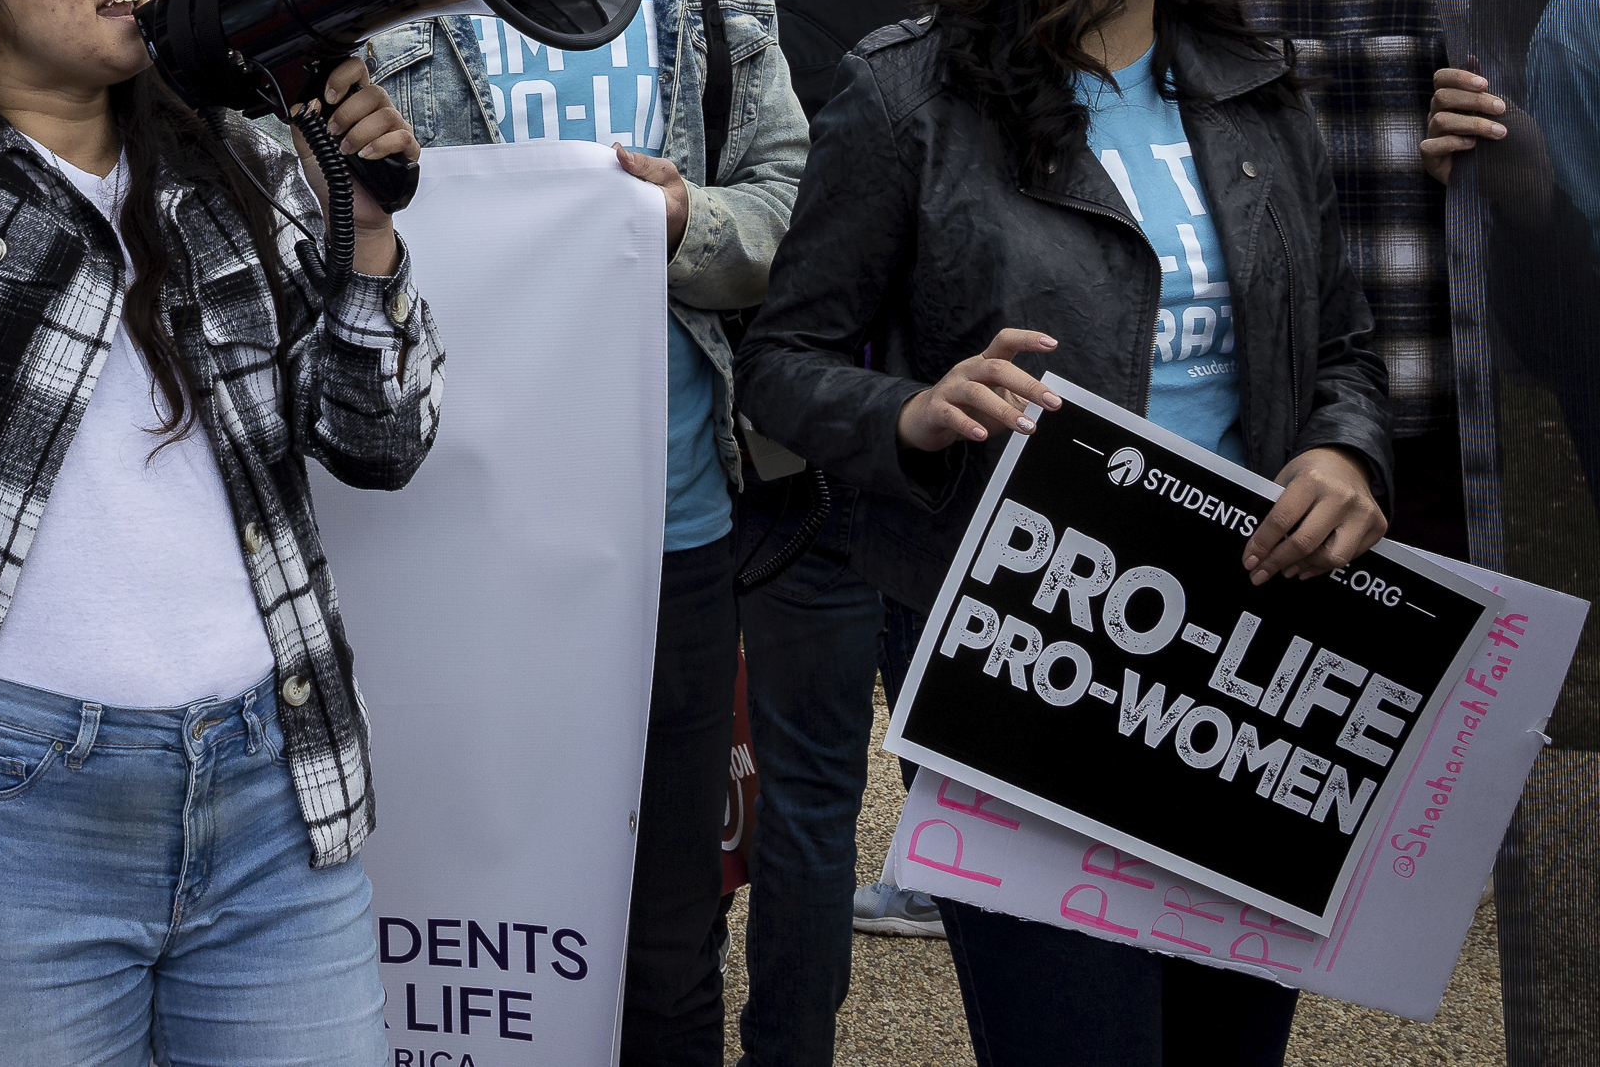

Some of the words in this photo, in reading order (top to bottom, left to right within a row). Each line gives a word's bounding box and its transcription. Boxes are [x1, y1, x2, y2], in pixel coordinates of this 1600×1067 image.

[1143, 468, 1258, 537] STUDENTS
[970, 498, 1424, 767] PRO-LIFE
[939, 594, 1377, 835] PRO-WOMEN
[405, 982, 533, 1042] LIFE
